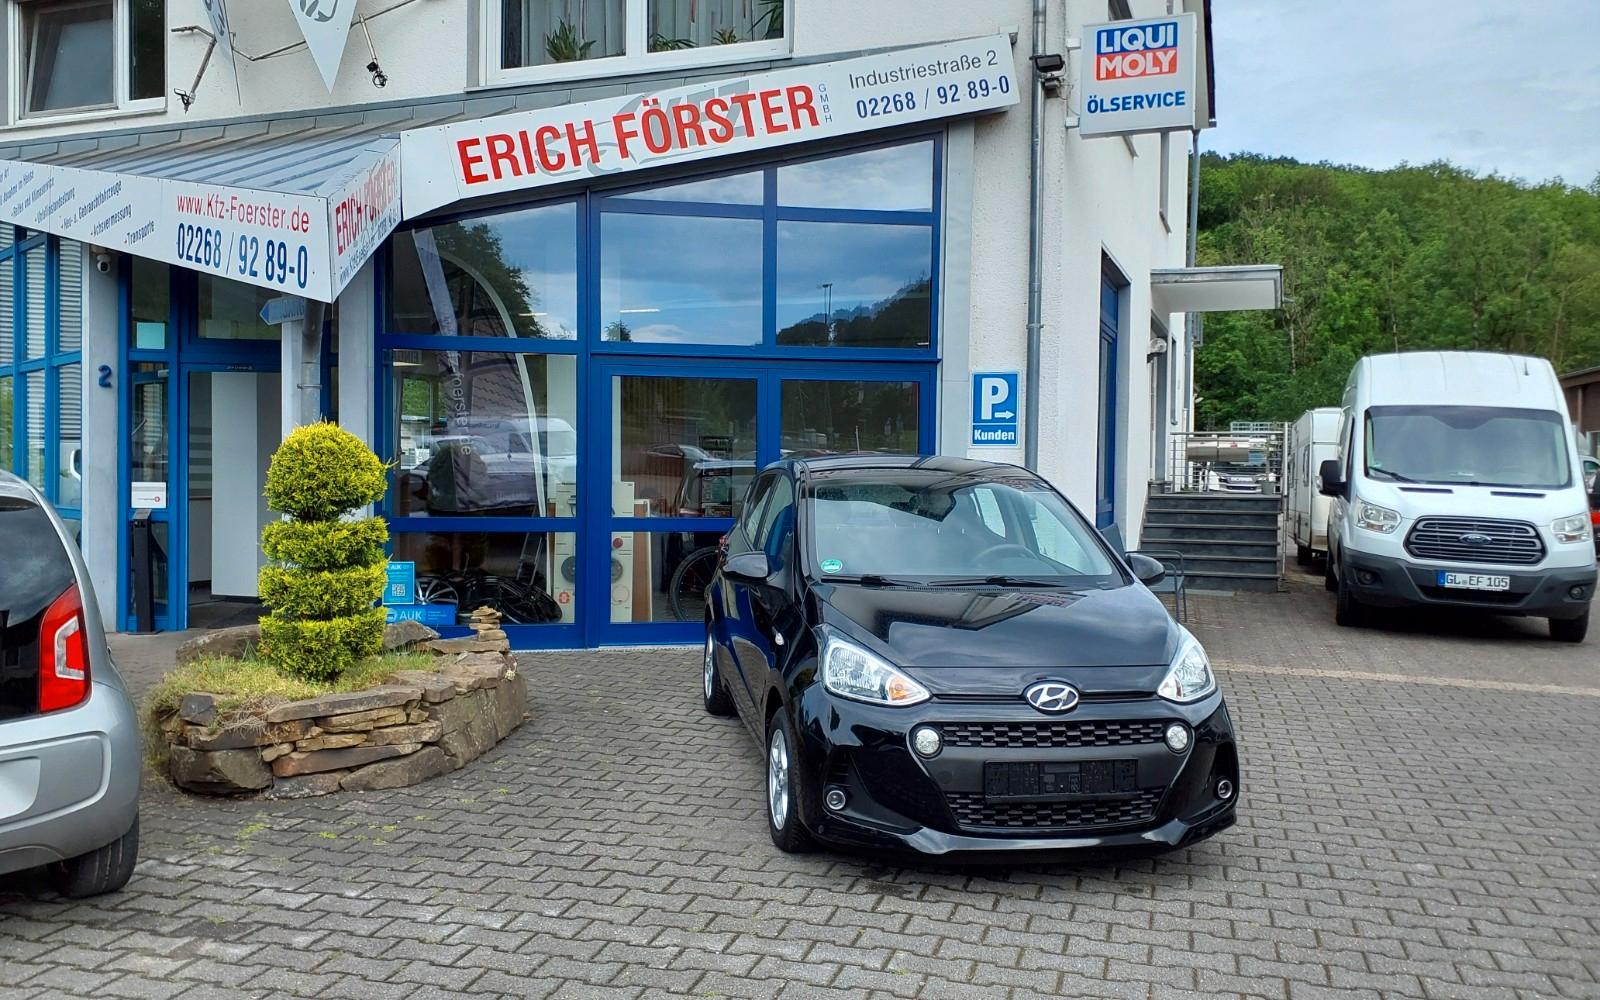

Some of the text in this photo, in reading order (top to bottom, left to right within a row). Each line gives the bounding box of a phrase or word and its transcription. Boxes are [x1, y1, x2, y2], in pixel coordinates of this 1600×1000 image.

[1099, 24, 1175, 54] LIQUI
[849, 49, 998, 90] Industriestraße 2
[1099, 50, 1176, 79] MOLY
[855, 91, 917, 119] 02268
[937, 83, 961, 105] 92
[968, 75, 1011, 101] 89-0
[1087, 91, 1186, 114] ÖLSERVICE
[457, 84, 820, 185] ERICH FÖRSTER
[176, 192, 310, 234] www.Kfz-Foerster.de
[335, 186, 363, 257] ERICH
[177, 222, 222, 269] 02268
[238, 234, 259, 278] 92
[265, 239, 308, 290] 89-0
[98, 365, 113, 388] 2
[981, 377, 1009, 420] P
[974, 429, 1015, 441] Kunden
[1446, 574, 1508, 588] GL EF 105
[400, 610, 422, 621] AUK
